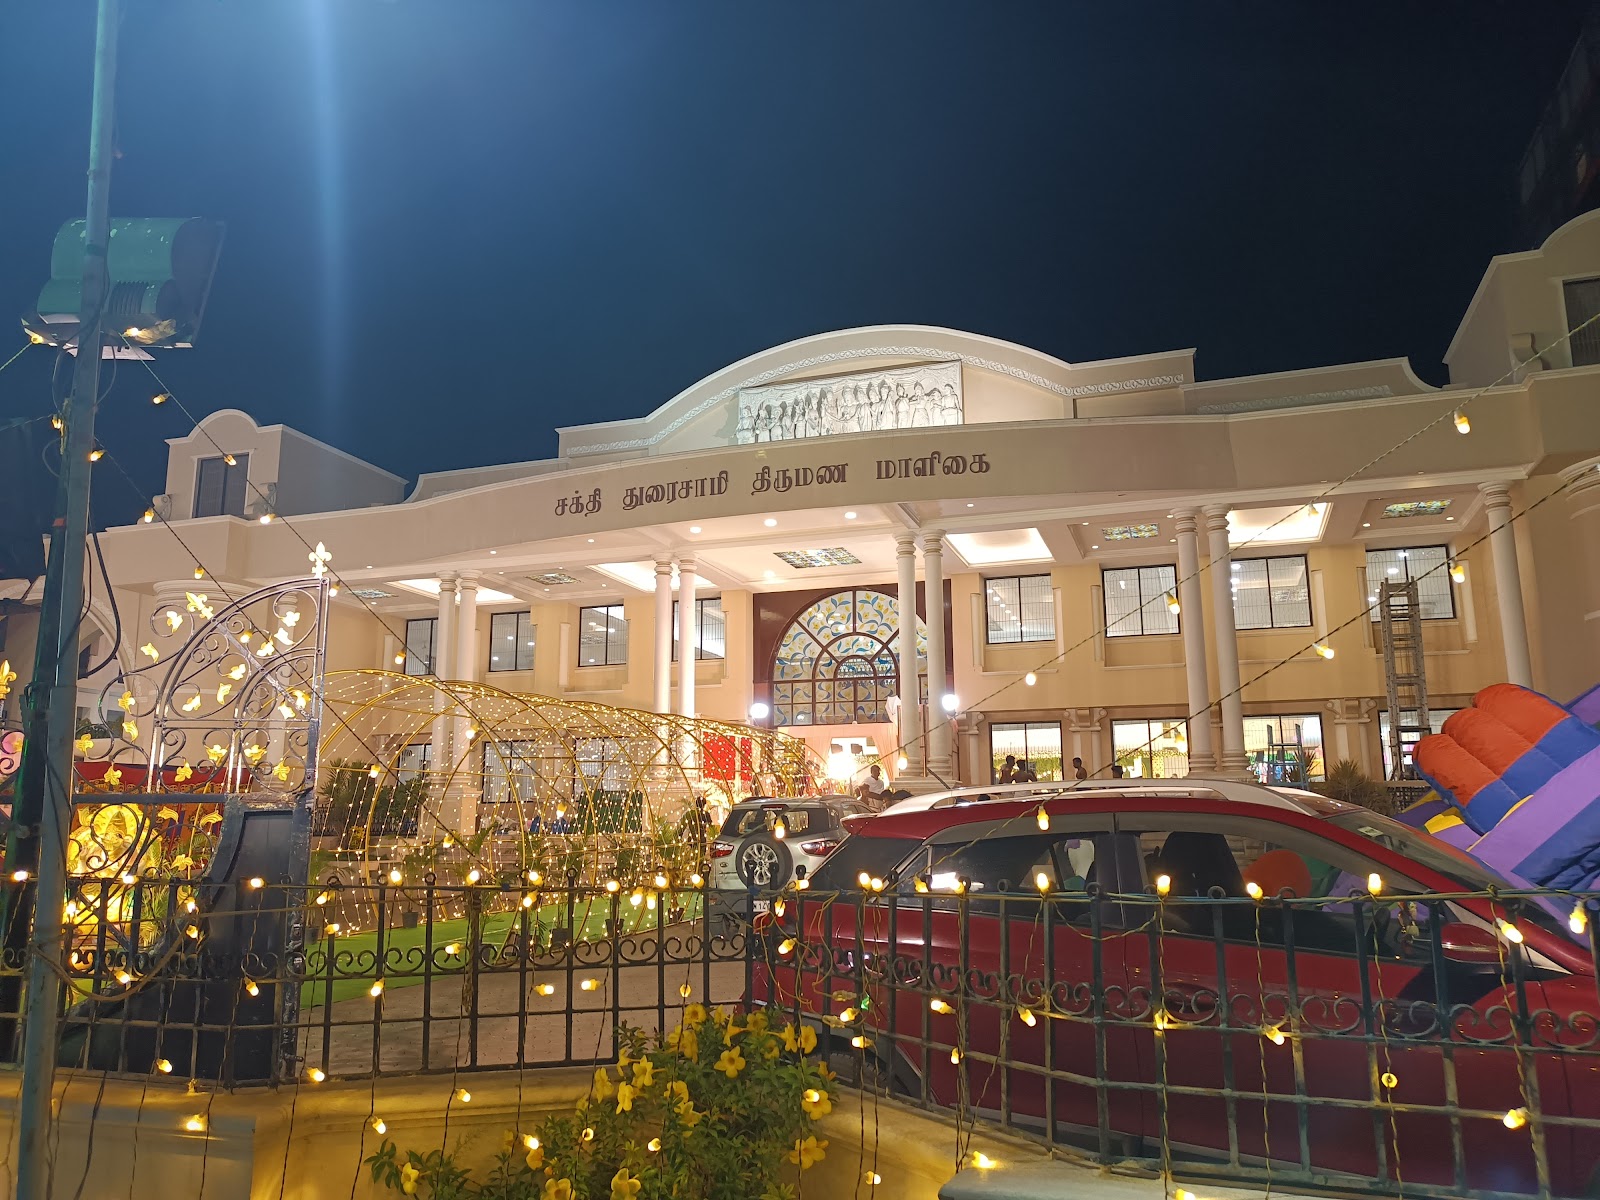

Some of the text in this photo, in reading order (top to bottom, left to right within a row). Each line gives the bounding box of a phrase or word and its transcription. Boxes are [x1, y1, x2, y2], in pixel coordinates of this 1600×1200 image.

[554, 450, 991, 517] சக்தி துரைசாமி திருமண மாளிகை
